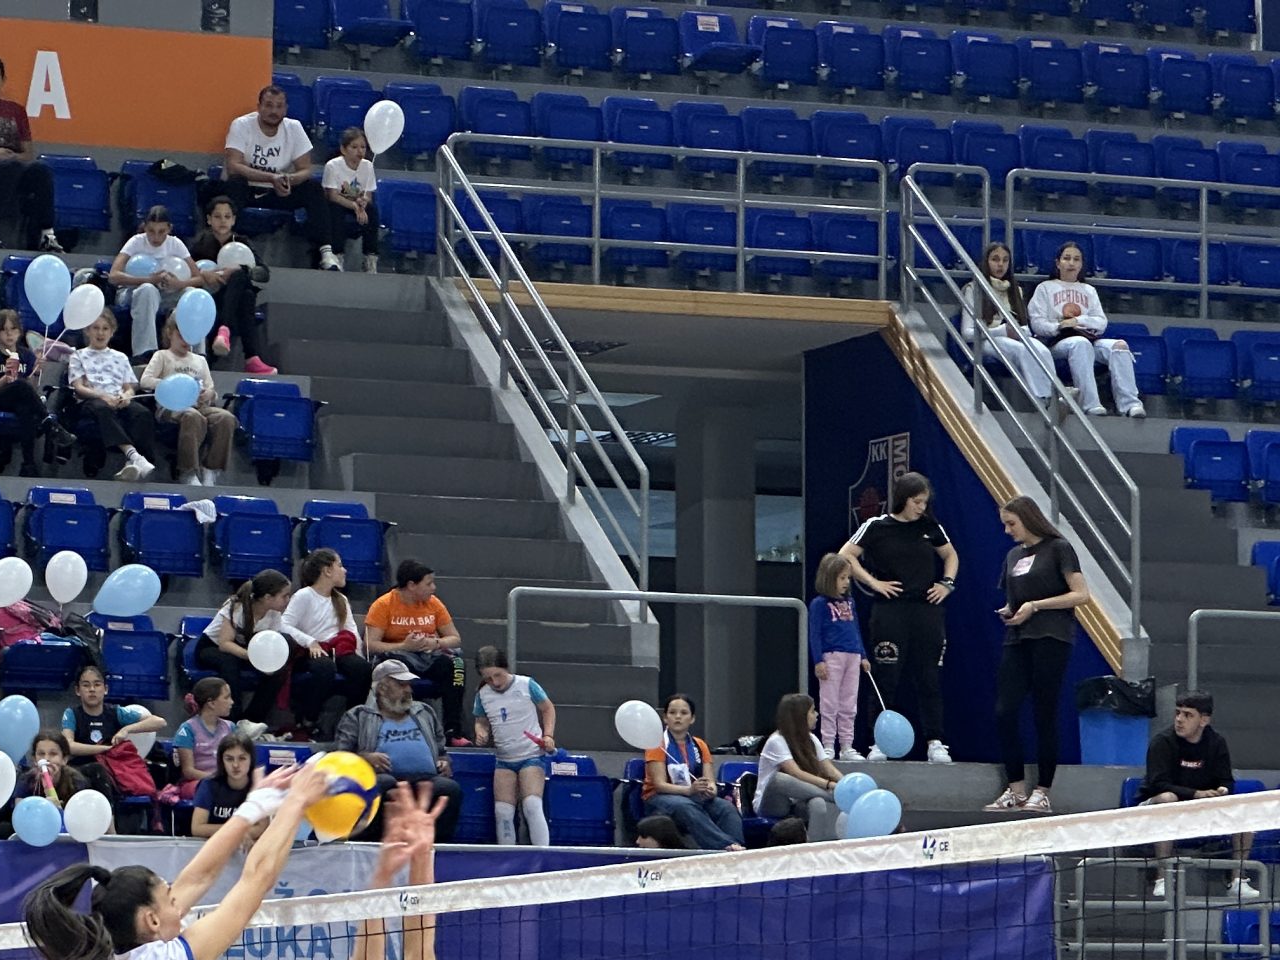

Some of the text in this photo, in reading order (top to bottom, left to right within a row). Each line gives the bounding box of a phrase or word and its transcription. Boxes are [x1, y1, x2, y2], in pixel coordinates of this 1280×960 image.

[254, 144, 281, 157] PLAY
[253, 154, 267, 166] TO
[872, 442, 888, 462] KK
[391, 616, 415, 626] LUKA
[214, 806, 233, 818] LUK
[650, 871, 663, 882] CEV
